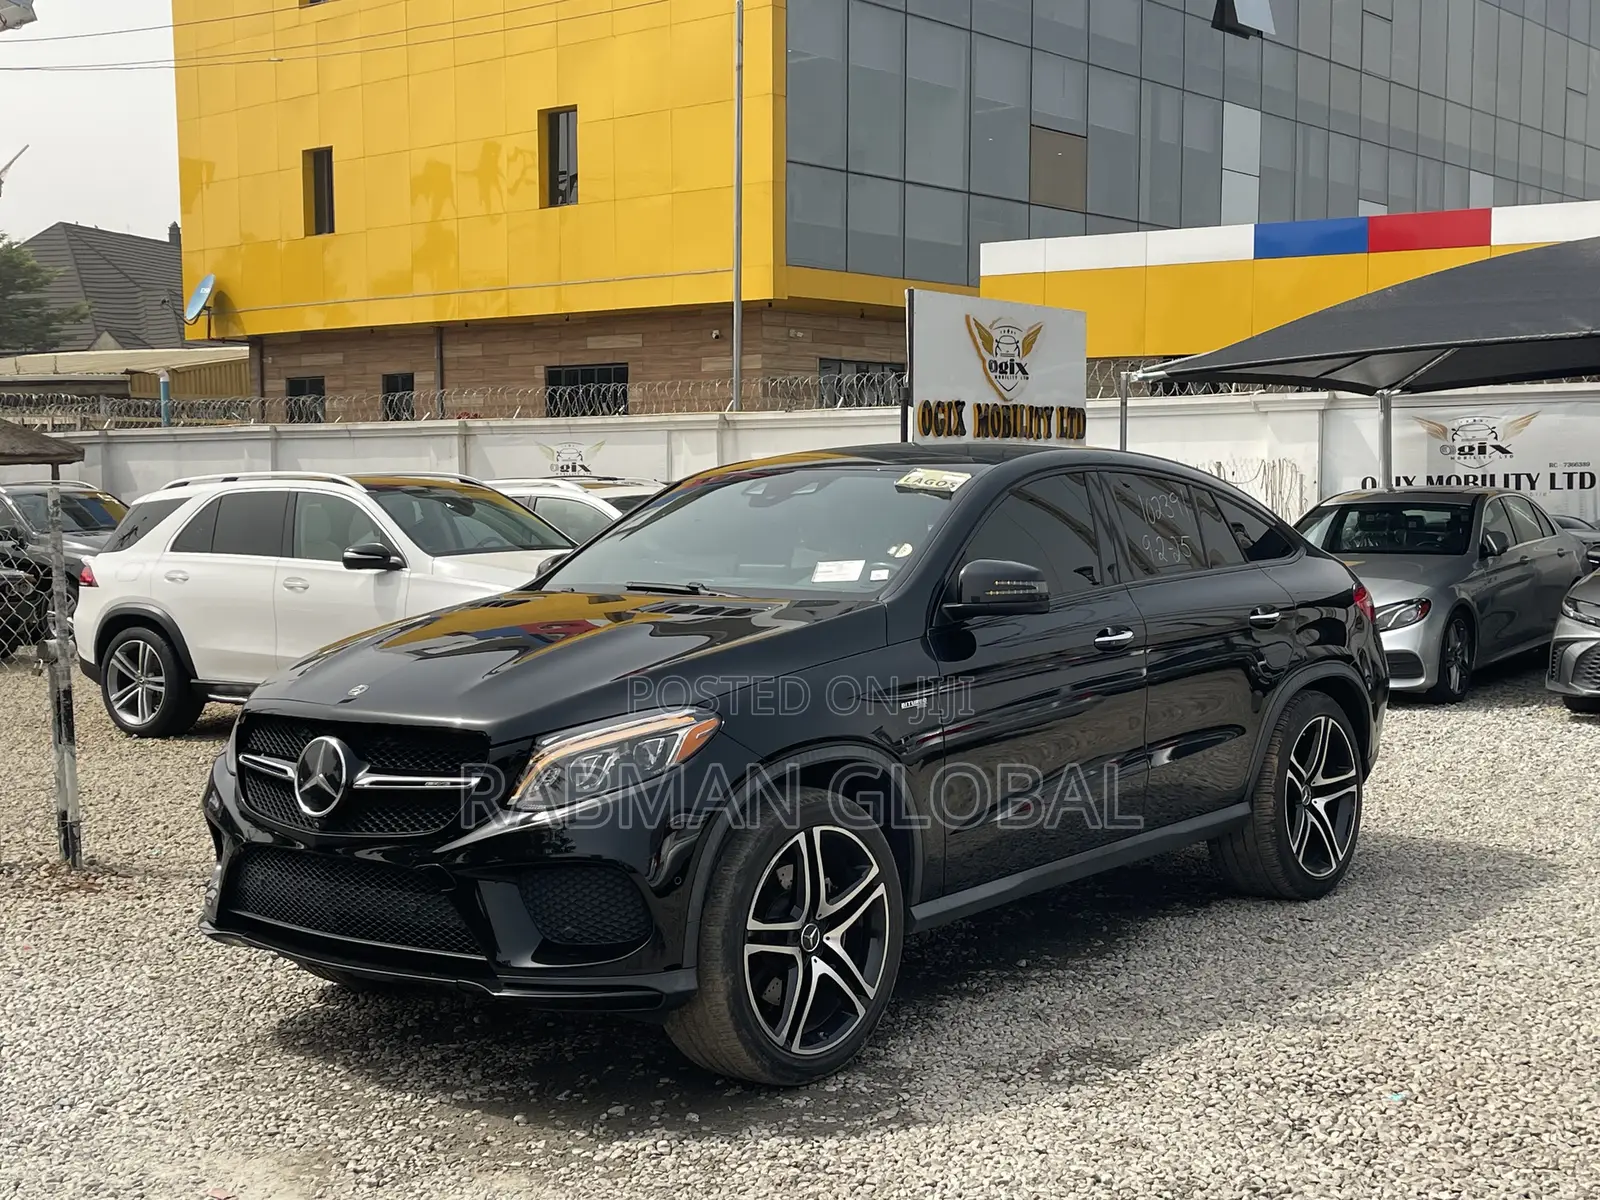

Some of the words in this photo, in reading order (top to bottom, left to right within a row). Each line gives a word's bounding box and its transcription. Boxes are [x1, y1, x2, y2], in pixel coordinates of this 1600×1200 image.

[918, 399, 967, 437] OGIX
[973, 402, 1054, 440] MOBILITY
[1056, 406, 1087, 440] LTD
[903, 477, 958, 489] LAGOS
[1361, 475, 1416, 490] OIX
[1549, 471, 1597, 490] LTD
